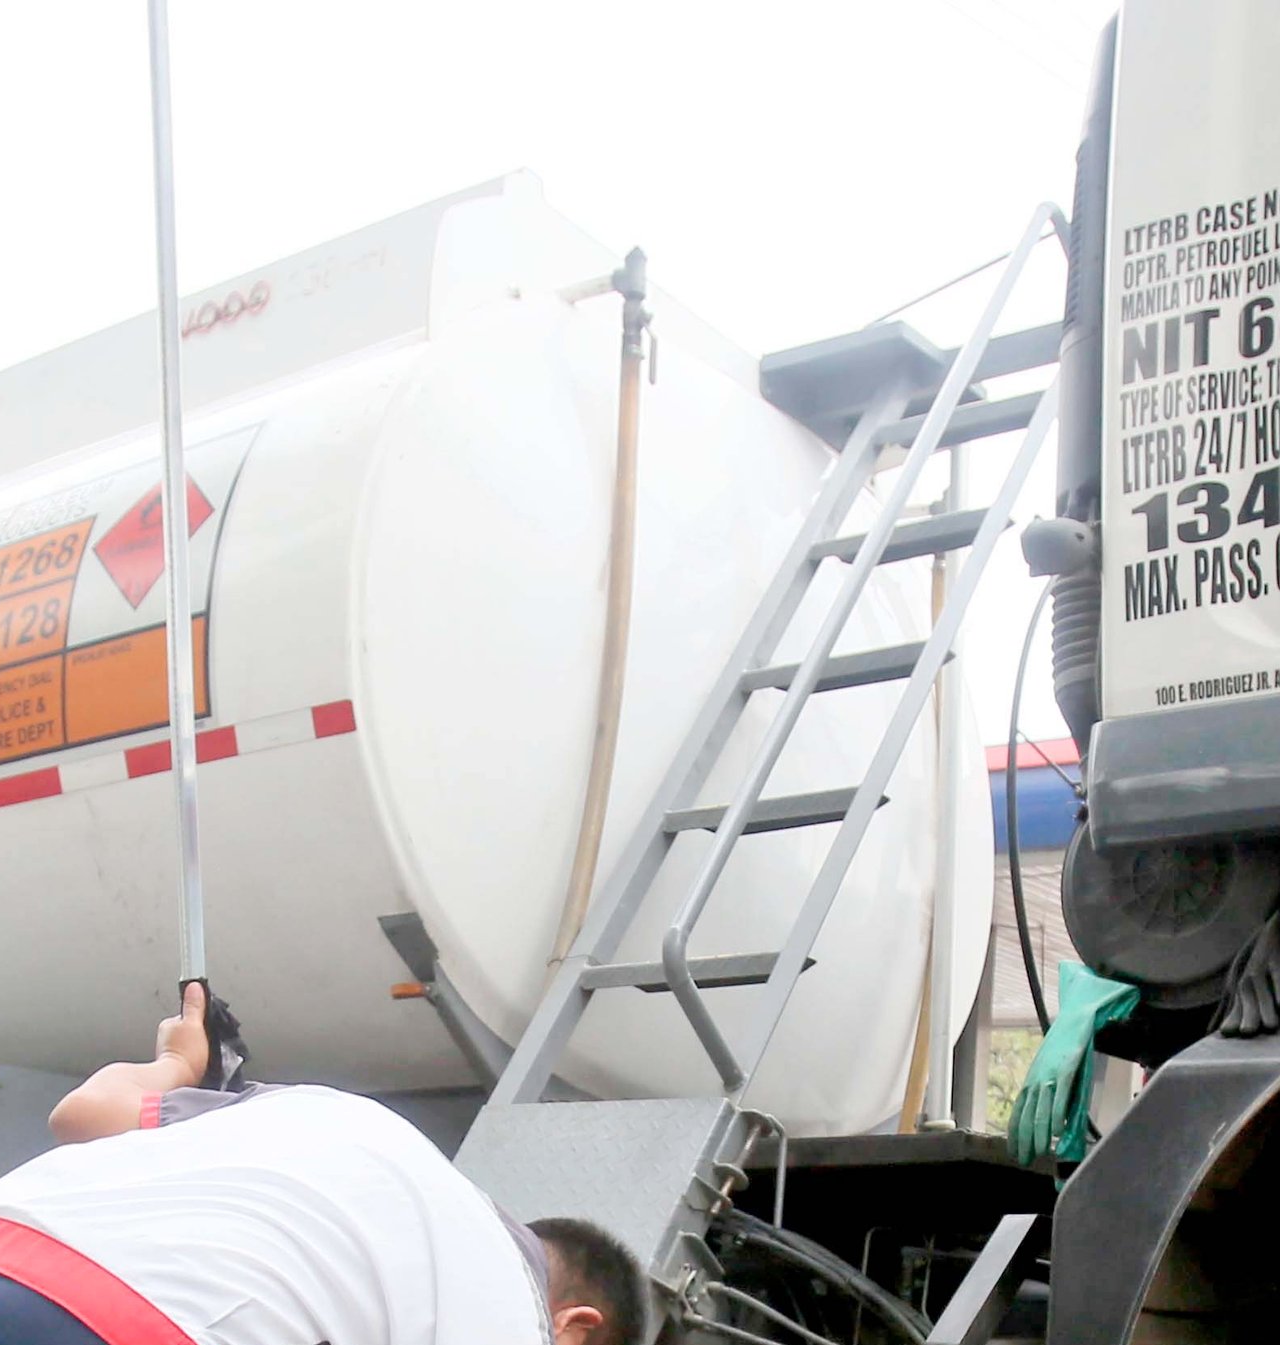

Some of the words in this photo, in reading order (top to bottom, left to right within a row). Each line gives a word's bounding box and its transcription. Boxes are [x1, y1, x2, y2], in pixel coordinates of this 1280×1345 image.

[1124, 214, 1188, 256] LTFRB
[1197, 198, 1256, 236] CASE
[1123, 251, 1170, 289] OPTR.
[1176, 228, 1271, 271] PETROFUEL
[1121, 284, 1179, 323] MANILA
[1184, 276, 1205, 304] TO
[1209, 268, 1243, 300] ANY
[1122, 309, 1220, 385] NIT
[1121, 380, 1159, 429] TYPE
[1163, 378, 1184, 416] OF
[1187, 358, 1262, 415] SERVICE:
[1122, 424, 1186, 494] LTFRB
[1194, 410, 1247, 475] 24/7
[1124, 555, 1187, 622] MAX.
[1195, 538, 1268, 607] PASS.
[0, 599, 61, 650] 128
[36, 696, 46, 714] &
[1155, 686, 1177, 706] 100
[1178, 684, 1188, 702] E.
[1189, 673, 1253, 701] RODRIGUEZ
[1256, 670, 1271, 691] JR.
[17, 719, 55, 746] DEPT
